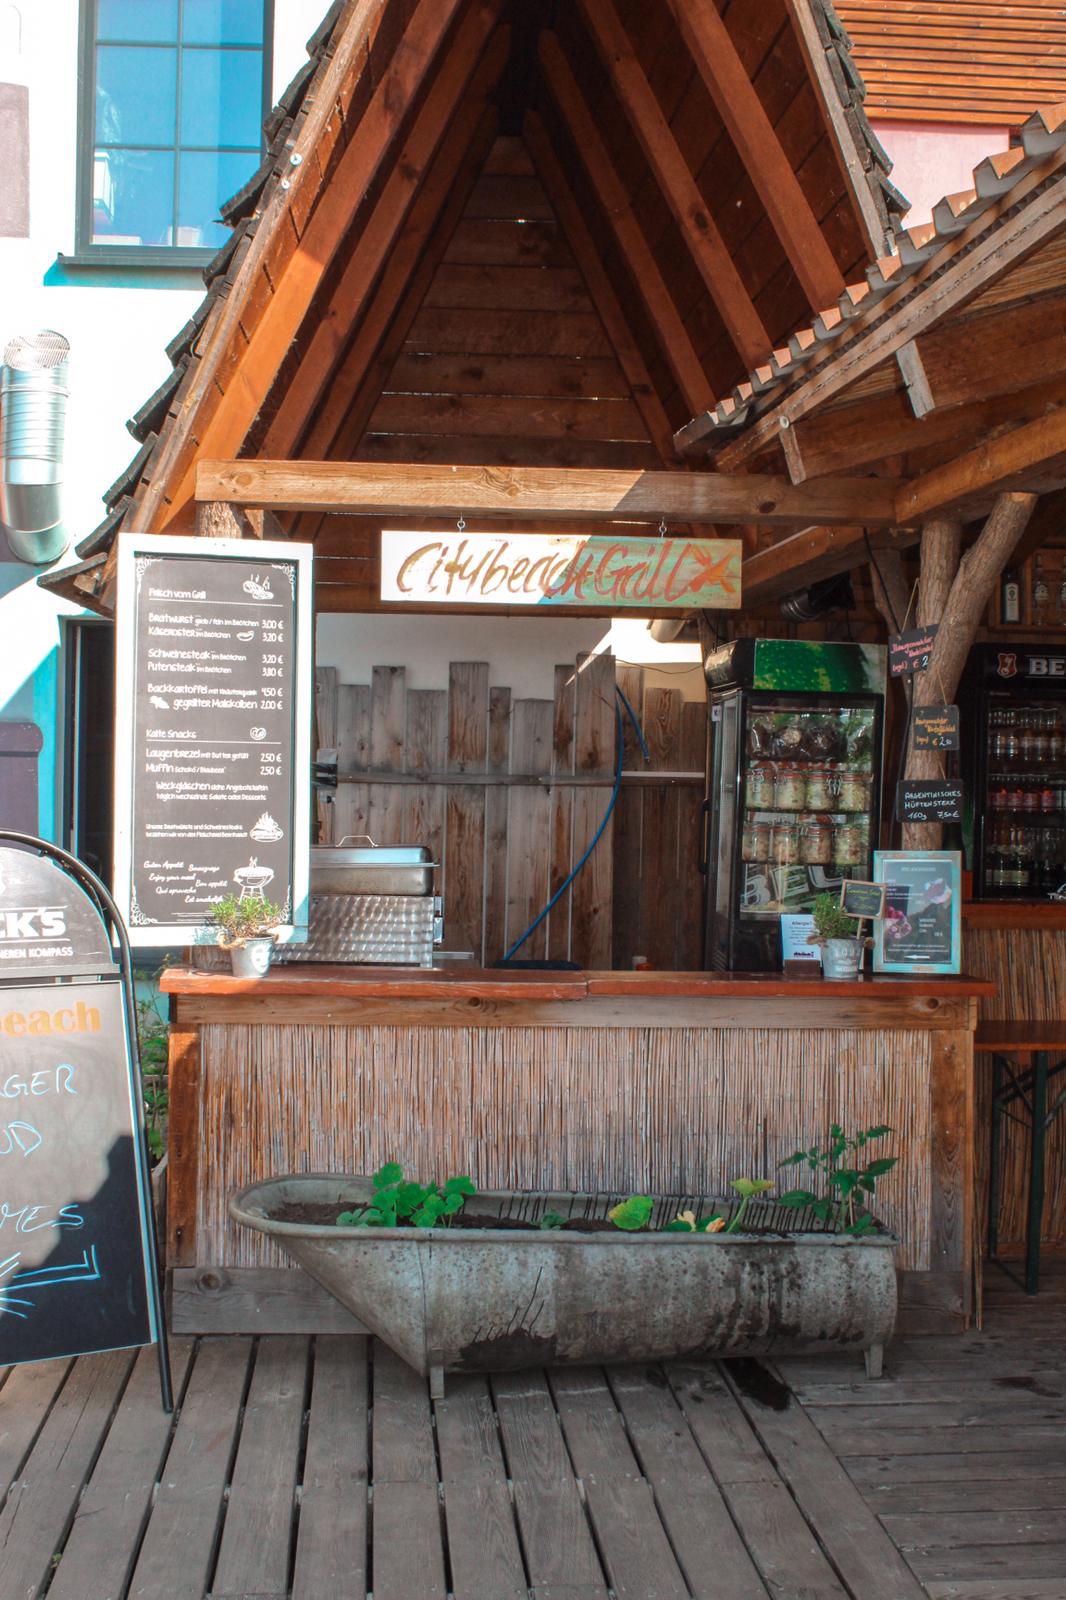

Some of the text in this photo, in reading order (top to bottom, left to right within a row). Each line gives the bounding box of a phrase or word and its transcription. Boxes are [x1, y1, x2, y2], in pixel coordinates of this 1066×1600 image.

[396, 539, 692, 602] Citybeach Grill
[174, 590, 191, 599] vom
[192, 590, 206, 600] Grill
[145, 729, 197, 739] Kalte Snacks
[145, 763, 174, 773] Muffin
[0, 946, 74, 959] EREN KOMPASS
[0, 999, 102, 1037] each
[0, 1063, 78, 1098] GER
